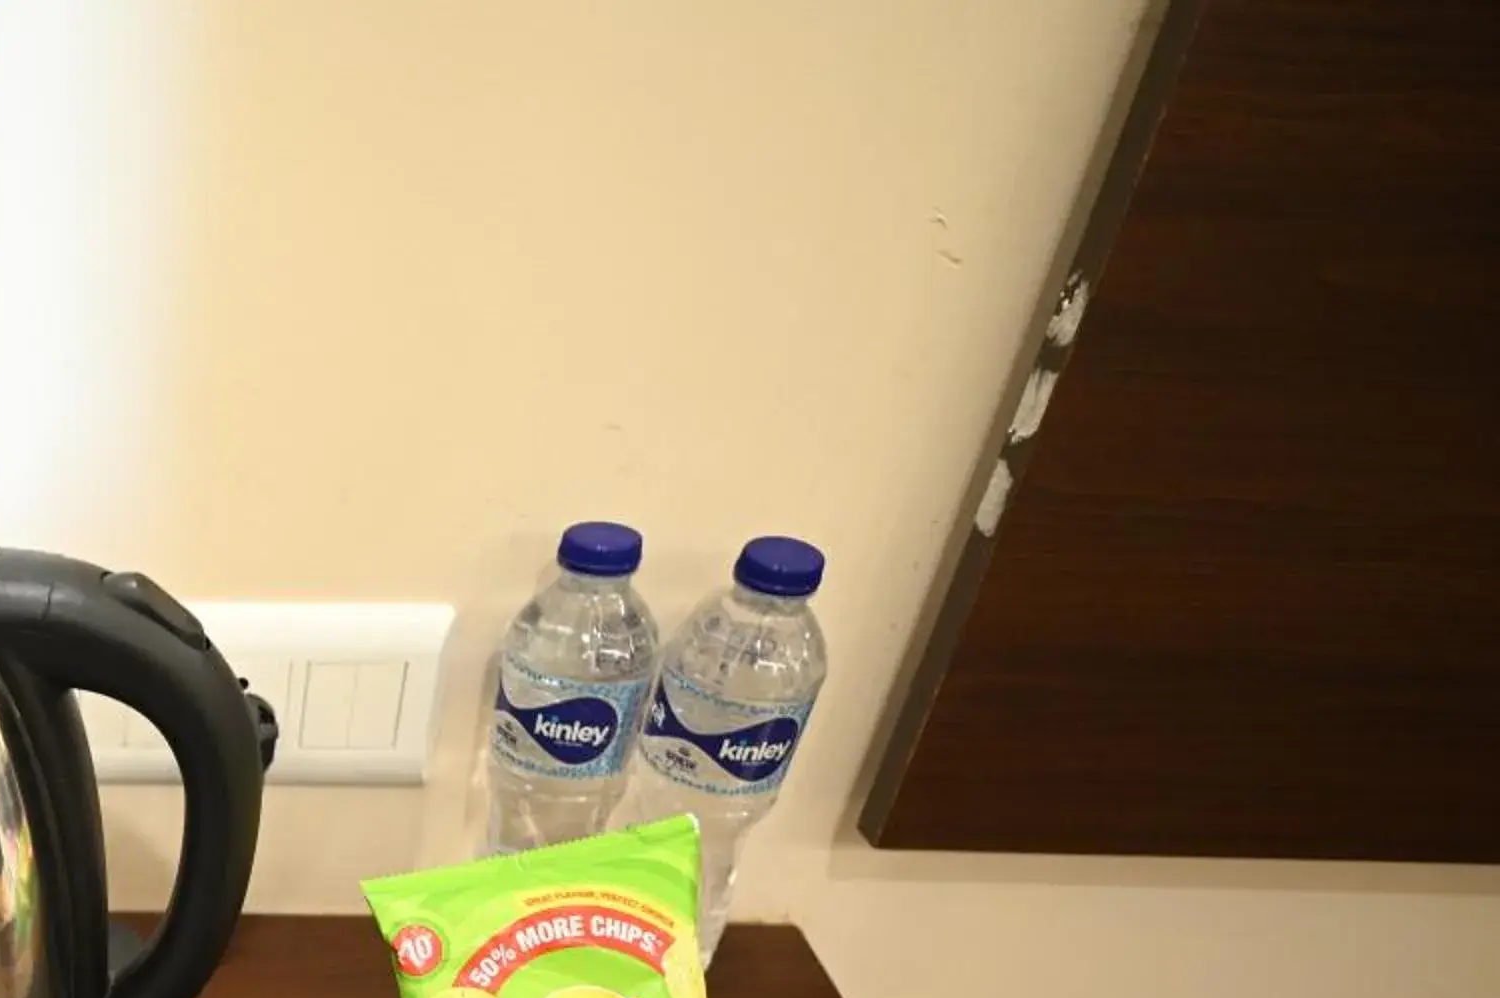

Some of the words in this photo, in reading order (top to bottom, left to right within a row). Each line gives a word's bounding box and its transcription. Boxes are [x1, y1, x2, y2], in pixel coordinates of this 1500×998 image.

[534, 714, 609, 746] kinley
[719, 739, 791, 763] kinley
[468, 944, 517, 988] 50%
[515, 915, 585, 952] MORE
